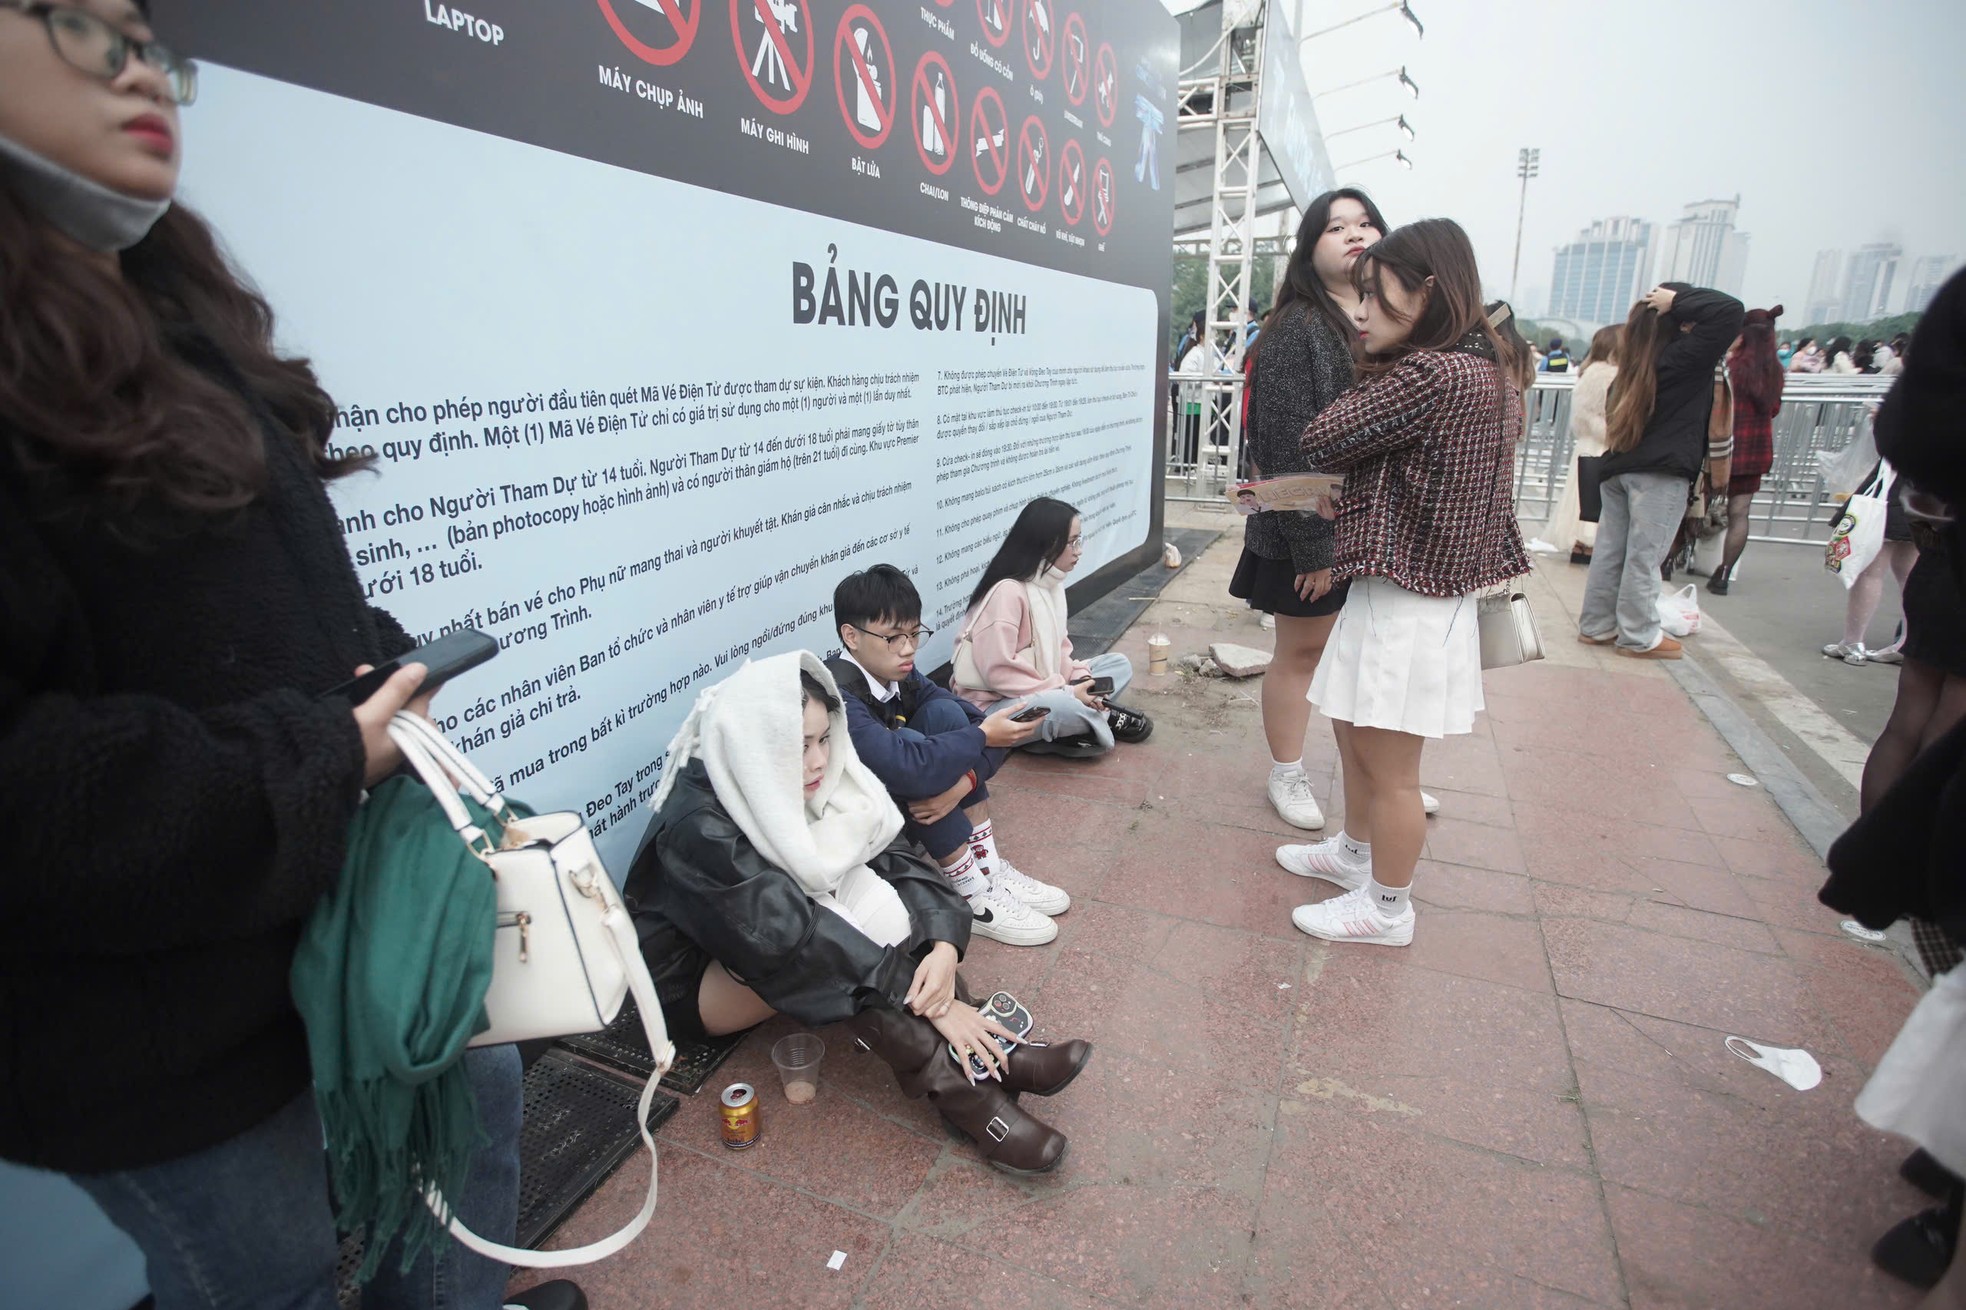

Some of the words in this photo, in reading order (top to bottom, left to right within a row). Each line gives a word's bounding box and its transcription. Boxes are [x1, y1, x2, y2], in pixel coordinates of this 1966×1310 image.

[424, 0, 505, 46] LAPTOP
[598, 65, 632, 93] MÁY
[636, 80, 674, 110] CHỤP
[677, 89, 704, 118] ẢNH
[740, 117, 764, 139] MÁY
[766, 128, 784, 146] GHI
[786, 132, 809, 154] HÌNH
[852, 156, 865, 176] BẬT
[867, 160, 880, 178] LỬA
[920, 182, 949, 202] CHAI/LON
[792, 243, 899, 329] BẢNG
[910, 278, 967, 332] QUY
[974, 288, 1027, 346] ĐỊNH
[335, 404, 380, 432] hận
[386, 402, 427, 424] cho
[433, 396, 483, 425] phép
[488, 392, 544, 419] người
[548, 388, 577, 411] đầu
[580, 390, 606, 408] tiên
[610, 386, 638, 409] quét
[641, 386, 659, 402] Mã
[661, 383, 676, 401] Vé
[679, 383, 703, 402] Điện
[706, 381, 721, 397] Tử
[724, 381, 752, 398] được
[754, 380, 777, 393] tham
[779, 378, 792, 394] dự
[794, 379, 805, 393] sự
[382, 439, 422, 463] quy
[429, 430, 478, 457] định.
[483, 425, 520, 449] Một
[525, 422, 544, 446] (1)
[549, 419, 573, 439] Mã
[576, 416, 594, 435] Vé
[598, 414, 627, 435] Điện
[630, 410, 648, 428] Tử
[652, 408, 669, 426] chỉ
[672, 406, 686, 423] có
[689, 404, 705, 425] giá
[707, 404, 718, 422] trị
[721, 401, 735, 418] sử
[738, 402, 761, 418] dụng
[764, 400, 780, 413] cho
[782, 397, 799, 413] một
[801, 396, 810, 411] (1)
[383, 503, 424, 526] cho
[430, 487, 496, 519] Người
[499, 483, 548, 503] Tham
[553, 476, 577, 496] Dự
[581, 469, 598, 488] từ
[602, 467, 617, 484] 14
[620, 458, 647, 480] tuổi.
[650, 453, 687, 476] Người
[689, 451, 718, 466] Tham
[721, 447, 737, 462] Dự
[739, 442, 751, 457] từ
[754, 441, 764, 454] 14
[766, 436, 782, 453] đến
[784, 434, 805, 449] dưới
[356, 538, 410, 566] sinh,
[447, 520, 488, 550] (bản
[493, 504, 579, 540] photocopy
[582, 494, 615, 515] hoặc
[617, 487, 643, 507] hình
[646, 480, 669, 500] ảnh)
[672, 476, 684, 493] và
[687, 473, 699, 490] có
[702, 467, 733, 488] người
[735, 464, 755, 479] thân
[757, 458, 779, 477] giám
[781, 456, 791, 471] hộ
[793, 453, 811, 469] (trên
[364, 571, 404, 599] ưới
[410, 563, 434, 586] 18
[439, 549, 483, 578] tuổi.
[487, 601, 520, 625] bán
[524, 590, 543, 612] vé
[548, 586, 575, 605] cho
[580, 575, 605, 595] Phụ
[609, 565, 626, 584] nữ
[630, 556, 661, 577] mang
[664, 545, 683, 564] thai
[686, 539, 698, 556] và
[700, 530, 731, 553] người
[733, 518, 763, 541] khuyết
[765, 517, 779, 532] tật.
[781, 509, 802, 526] Khán
[804, 504, 816, 522] giả
[434, 715, 458, 734] ho
[464, 697, 496, 722] các
[501, 679, 541, 707] nhân
[545, 664, 576, 686] viên
[579, 651, 606, 672] Ban
[608, 636, 620, 658] tổ
[624, 628, 653, 651] chức
[656, 618, 668, 635] và
[671, 609, 695, 629] nhân
[697, 599, 717, 616] viên
[719, 596, 724, 610] y
[726, 585, 736, 603] tế
[737, 584, 752, 598] trợ
[754, 575, 772, 594] giúp
[774, 569, 789, 584] vận
[791, 555, 819, 577] chuyển
[499, 622, 547, 650] ương
[550, 605, 592, 630] Trình.
[500, 709, 525, 739] giả
[530, 697, 553, 721] chi
[556, 685, 581, 708] trả.
[510, 758, 544, 786] mua
[548, 735, 587, 764] trong
[591, 716, 612, 742] bất
[615, 709, 625, 728] kì
[628, 688, 667, 719] trường
[670, 675, 690, 694] hợp
[693, 663, 712, 681] nào.
[714, 650, 728, 667] Vui
[731, 643, 749, 659] lòng
[752, 620, 795, 648] ngồi/đứng
[798, 611, 817, 626] đúng
[586, 794, 612, 818] Đeo
[614, 777, 633, 797] Tay
[636, 756, 663, 782] trong
[610, 797, 637, 826] hành
